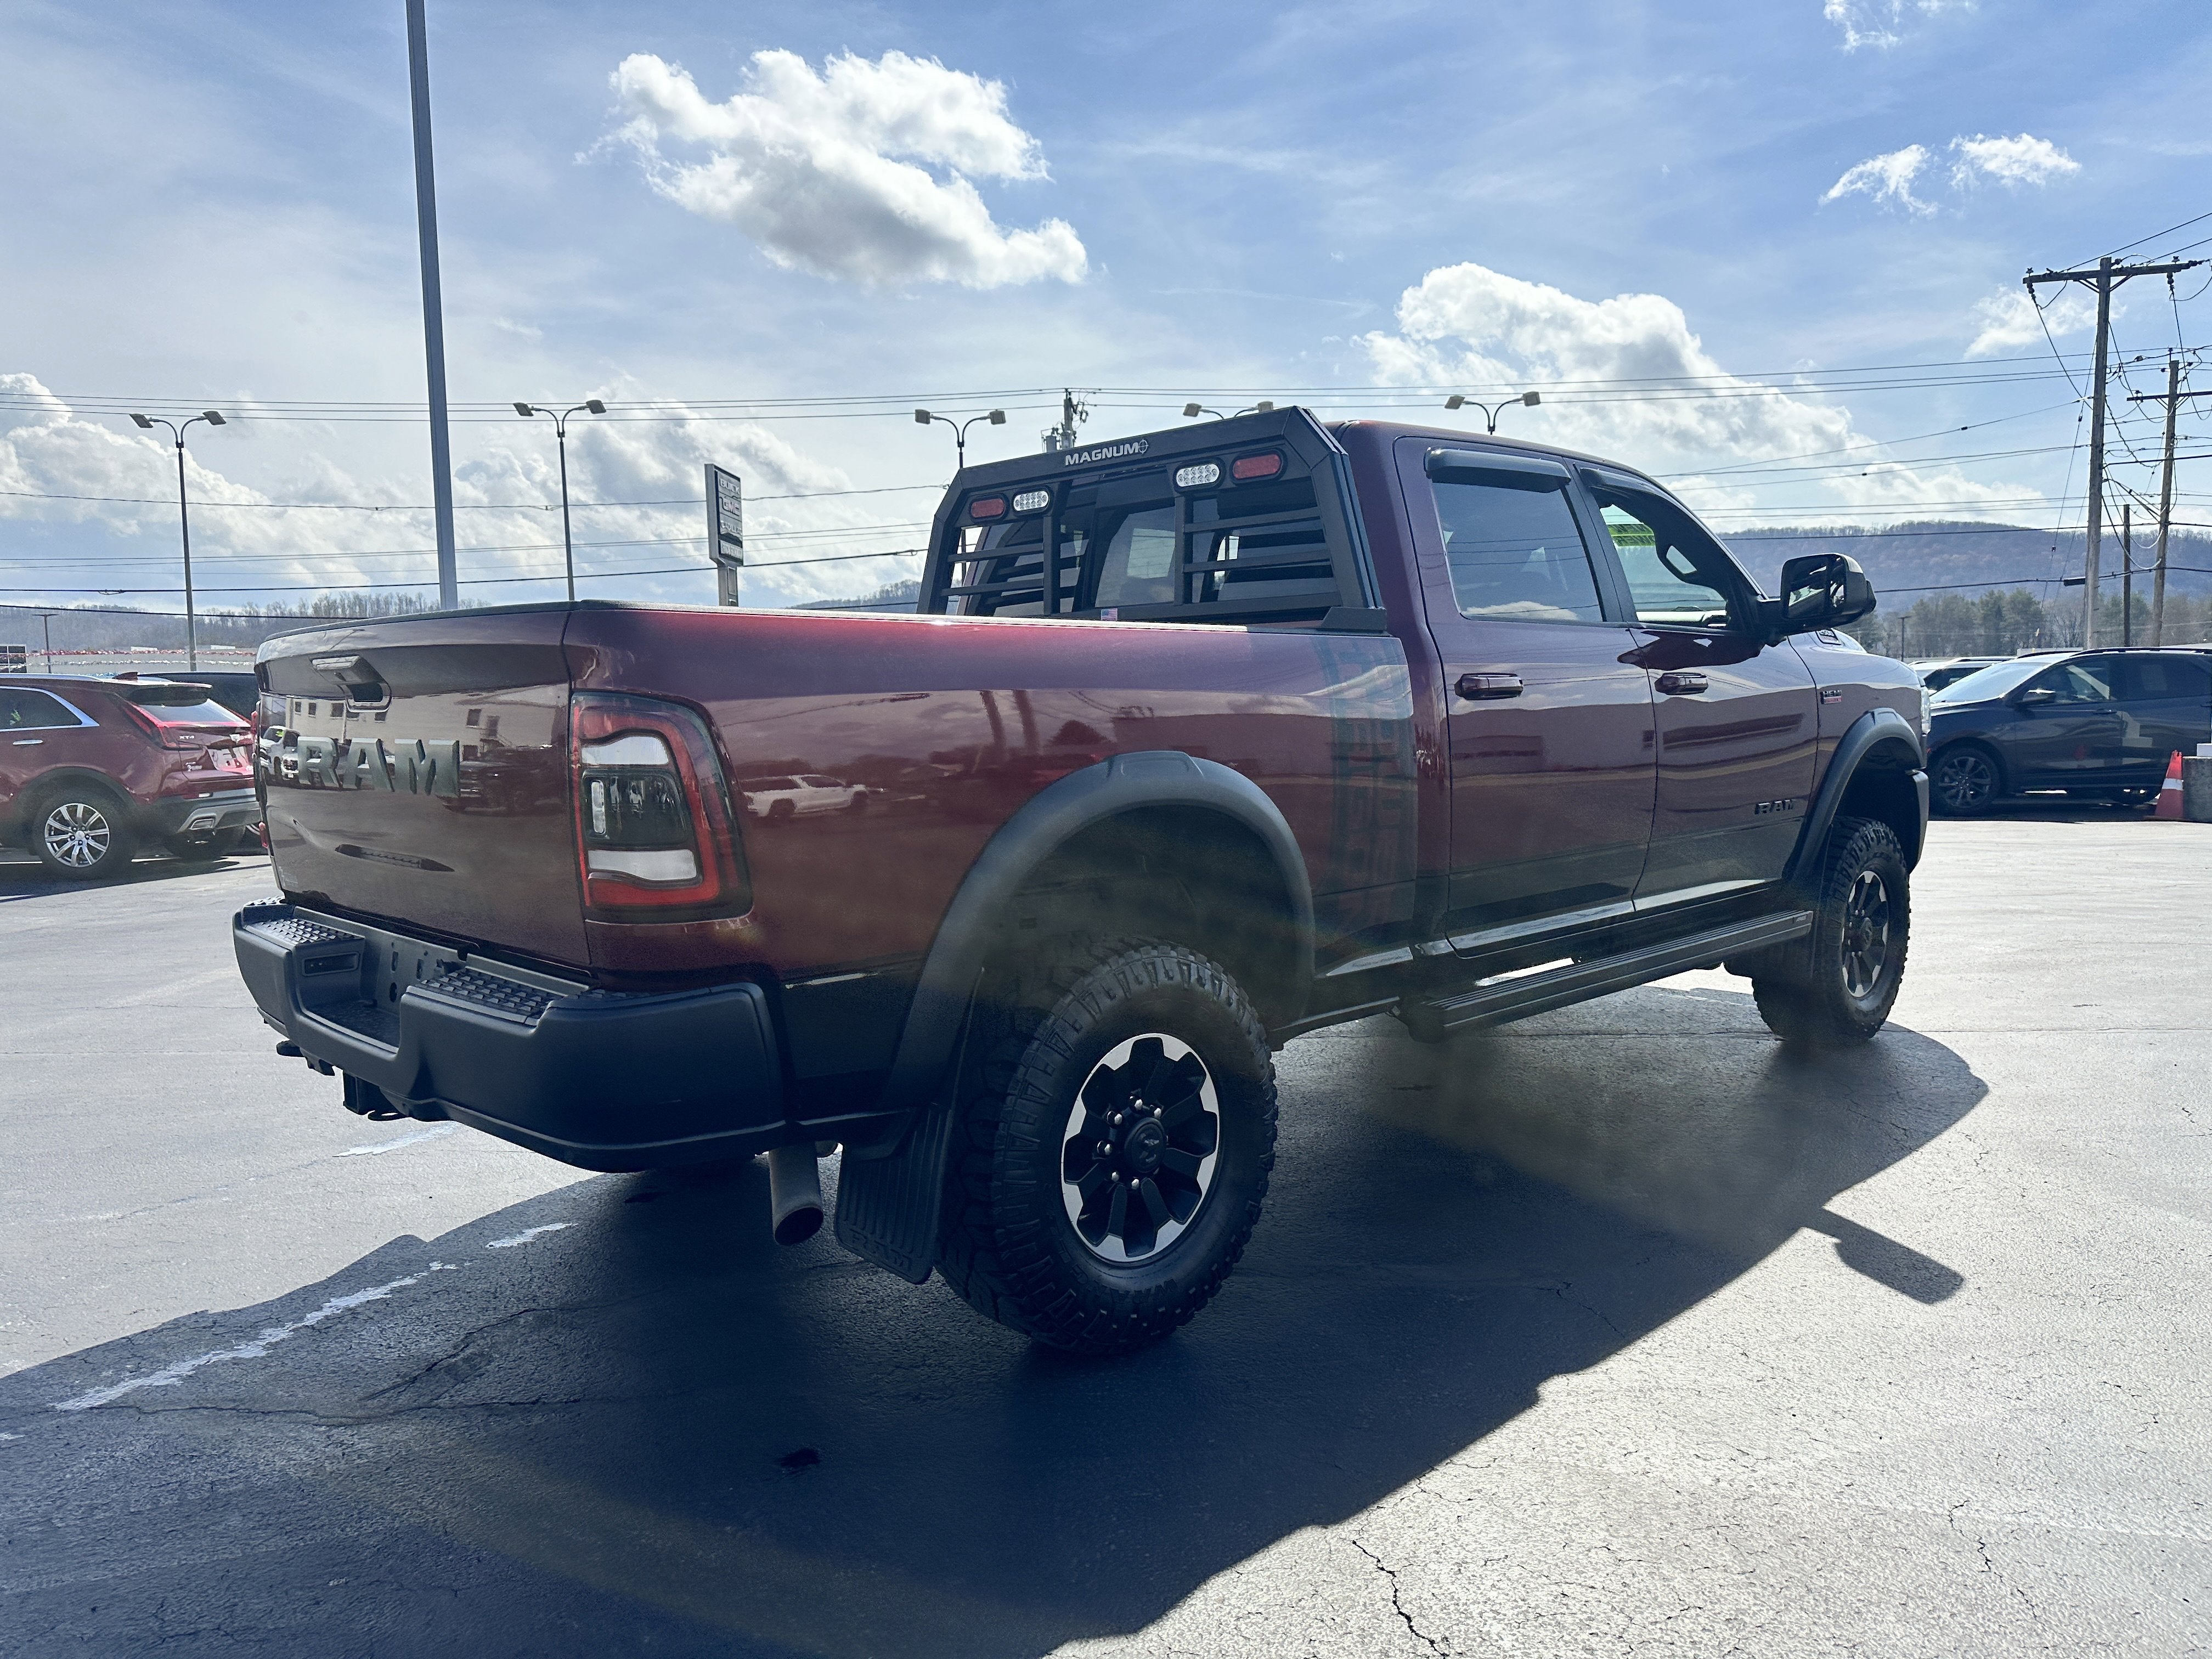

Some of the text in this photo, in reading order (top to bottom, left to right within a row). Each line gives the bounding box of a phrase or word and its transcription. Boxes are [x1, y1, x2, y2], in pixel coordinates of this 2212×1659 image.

[1065, 442, 1139, 466] MAGNUM
[719, 478, 740, 495] BUICK
[723, 498, 740, 516] GMC
[297, 736, 460, 798] RAM
[1754, 799, 1795, 815] RAM
